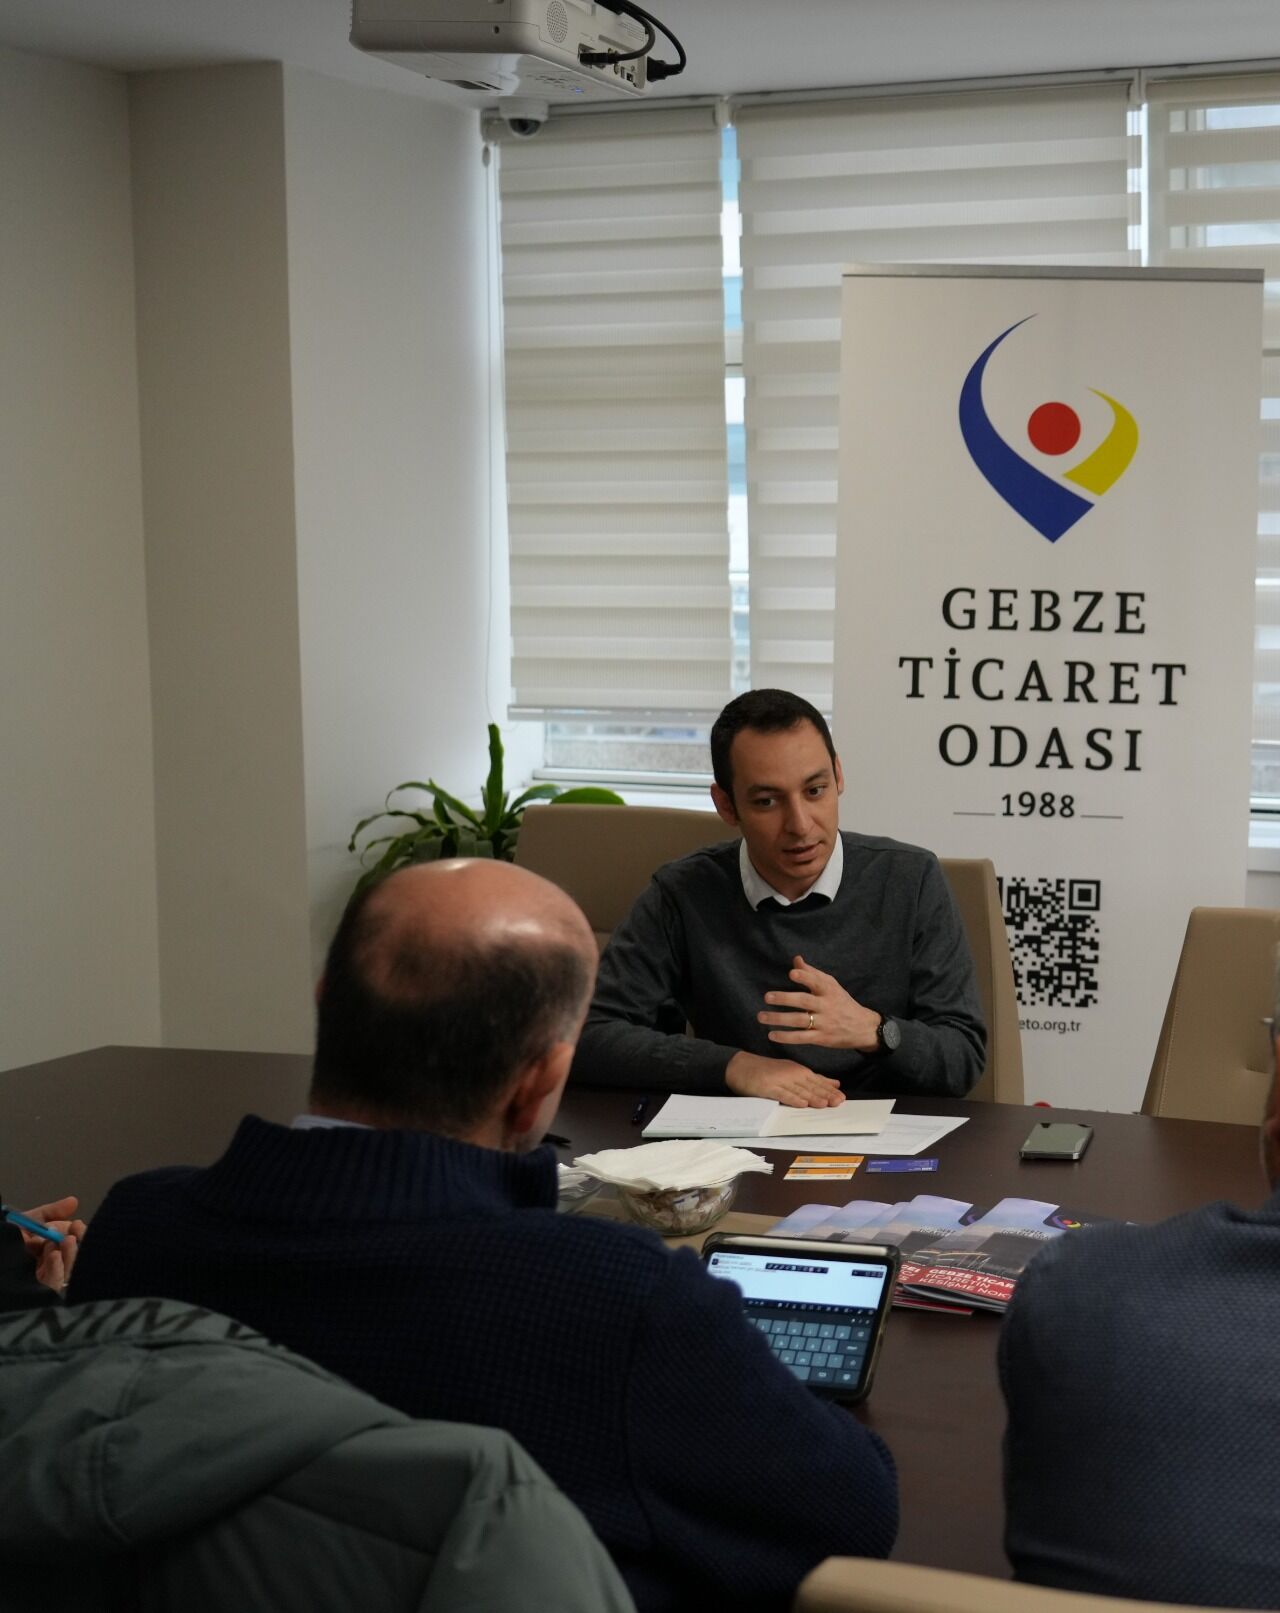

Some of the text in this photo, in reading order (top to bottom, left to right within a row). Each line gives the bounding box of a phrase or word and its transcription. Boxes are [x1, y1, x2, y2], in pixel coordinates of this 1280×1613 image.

[941, 587, 1147, 635] GEBZE
[898, 647, 1187, 706] TİCARET
[938, 723, 1143, 772] ODASI
[1000, 790, 1076, 819] 1988
[1019, 1018, 1081, 1033] eto.org.tr
[976, 1275, 1015, 1288] TİCAR
[978, 1287, 1012, 1299] NOK
